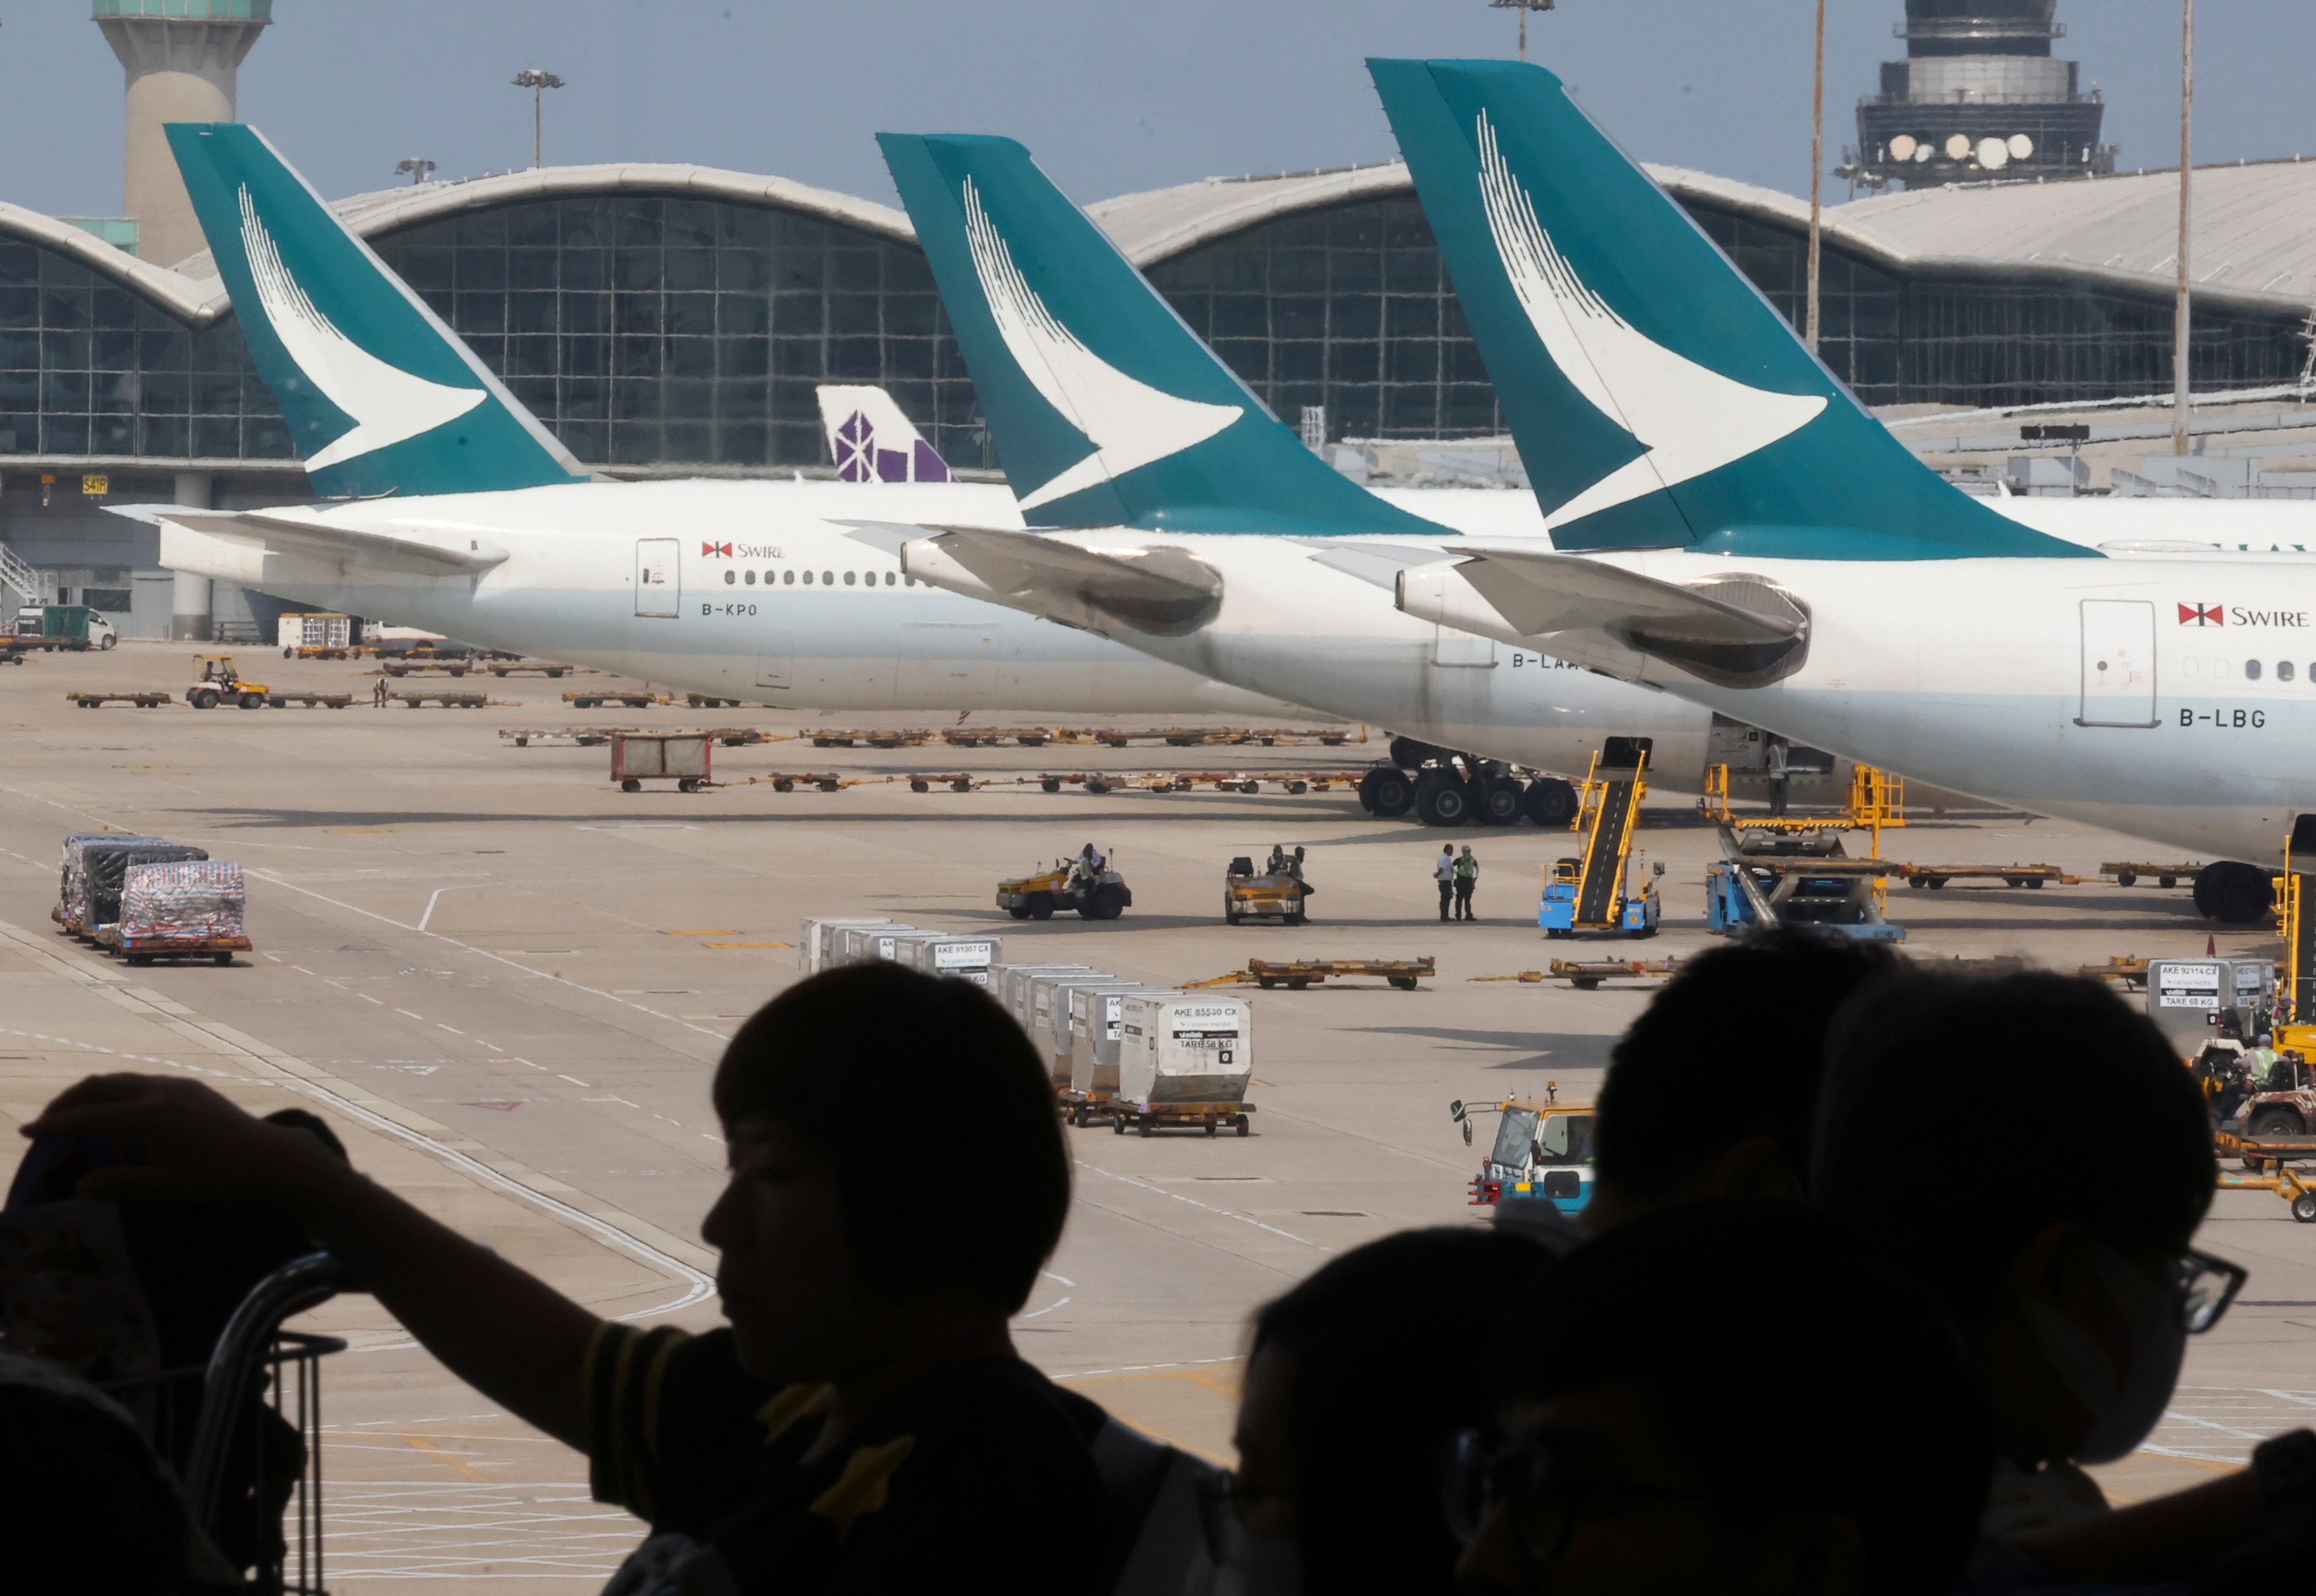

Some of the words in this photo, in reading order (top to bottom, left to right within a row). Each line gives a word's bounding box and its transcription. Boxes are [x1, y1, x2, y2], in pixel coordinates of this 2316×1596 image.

[2232, 607, 2310, 628] SWIRE
[2180, 709, 2265, 727] B-LBG
[1219, 1040, 1232, 1048] KG
